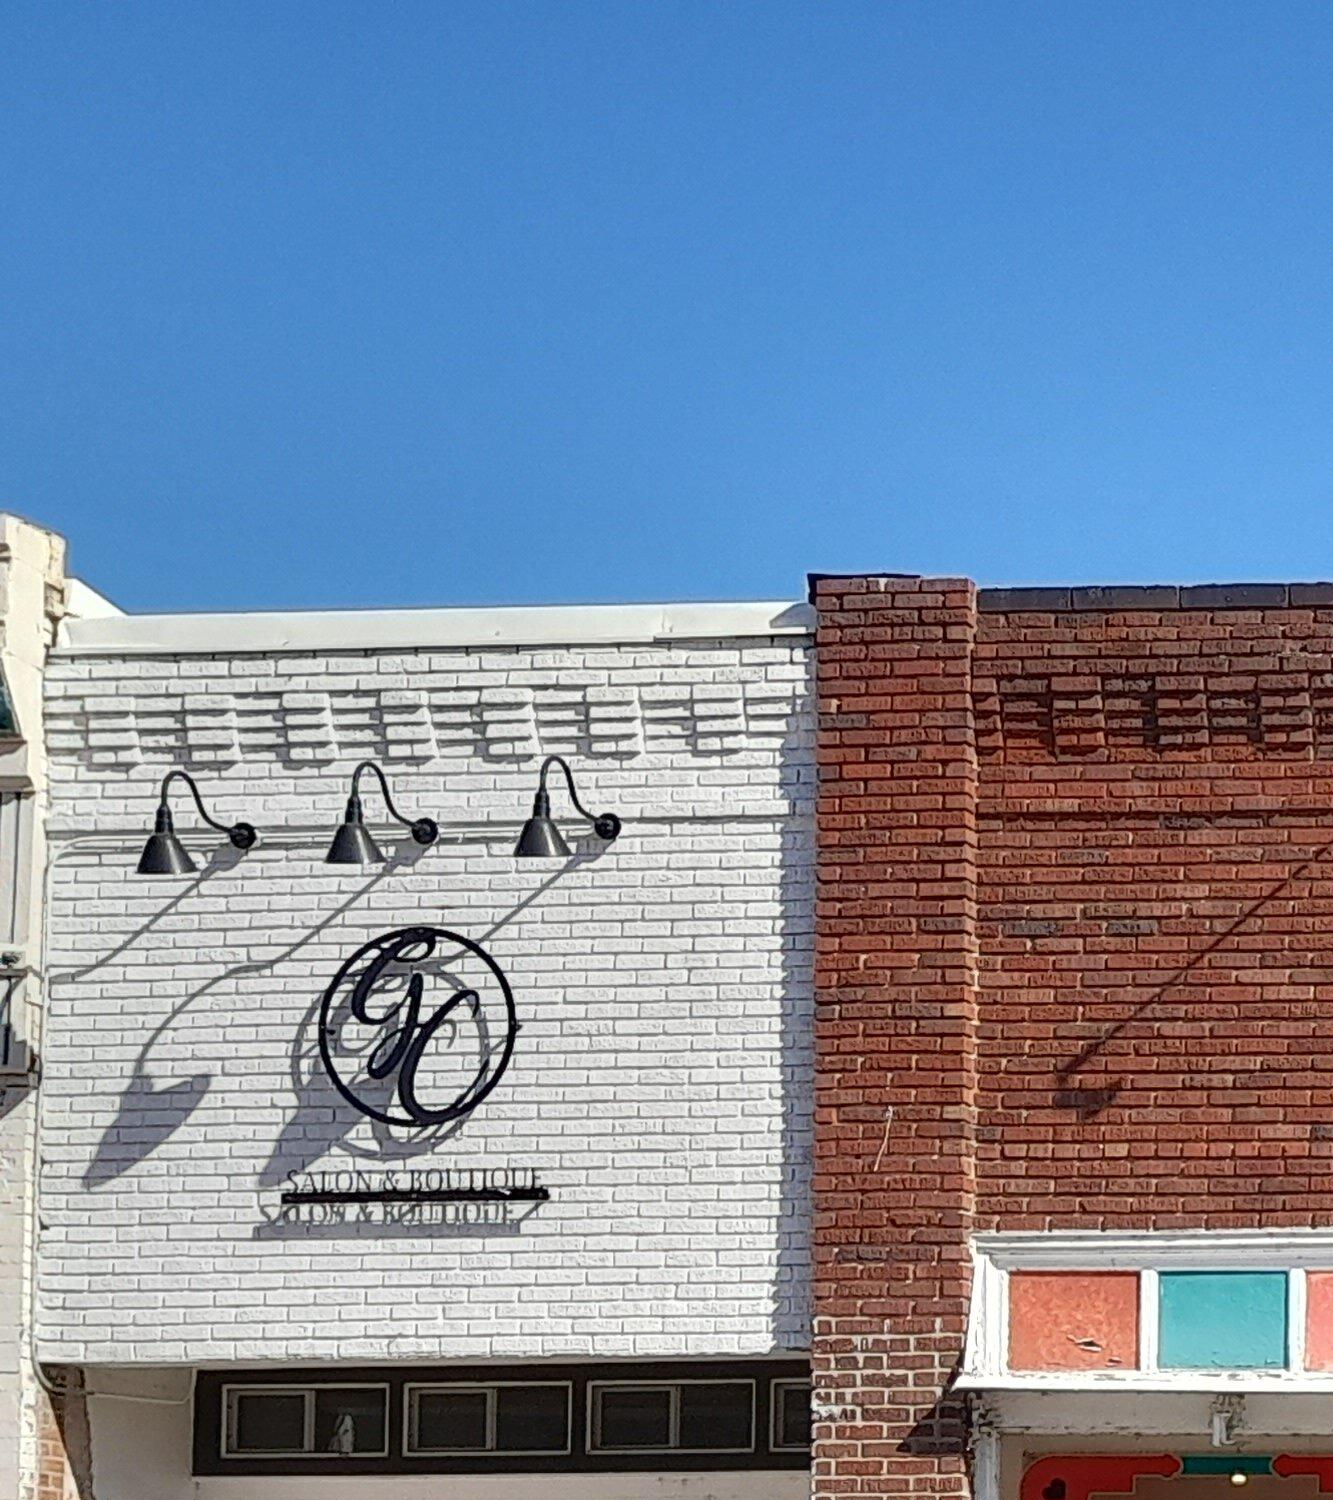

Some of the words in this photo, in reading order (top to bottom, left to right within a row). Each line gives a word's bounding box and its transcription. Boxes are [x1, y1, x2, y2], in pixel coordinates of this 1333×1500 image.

[288, 1169, 372, 1193] SALON
[382, 1170, 399, 1192] &
[410, 1167, 541, 1192] BOUTIQUE
